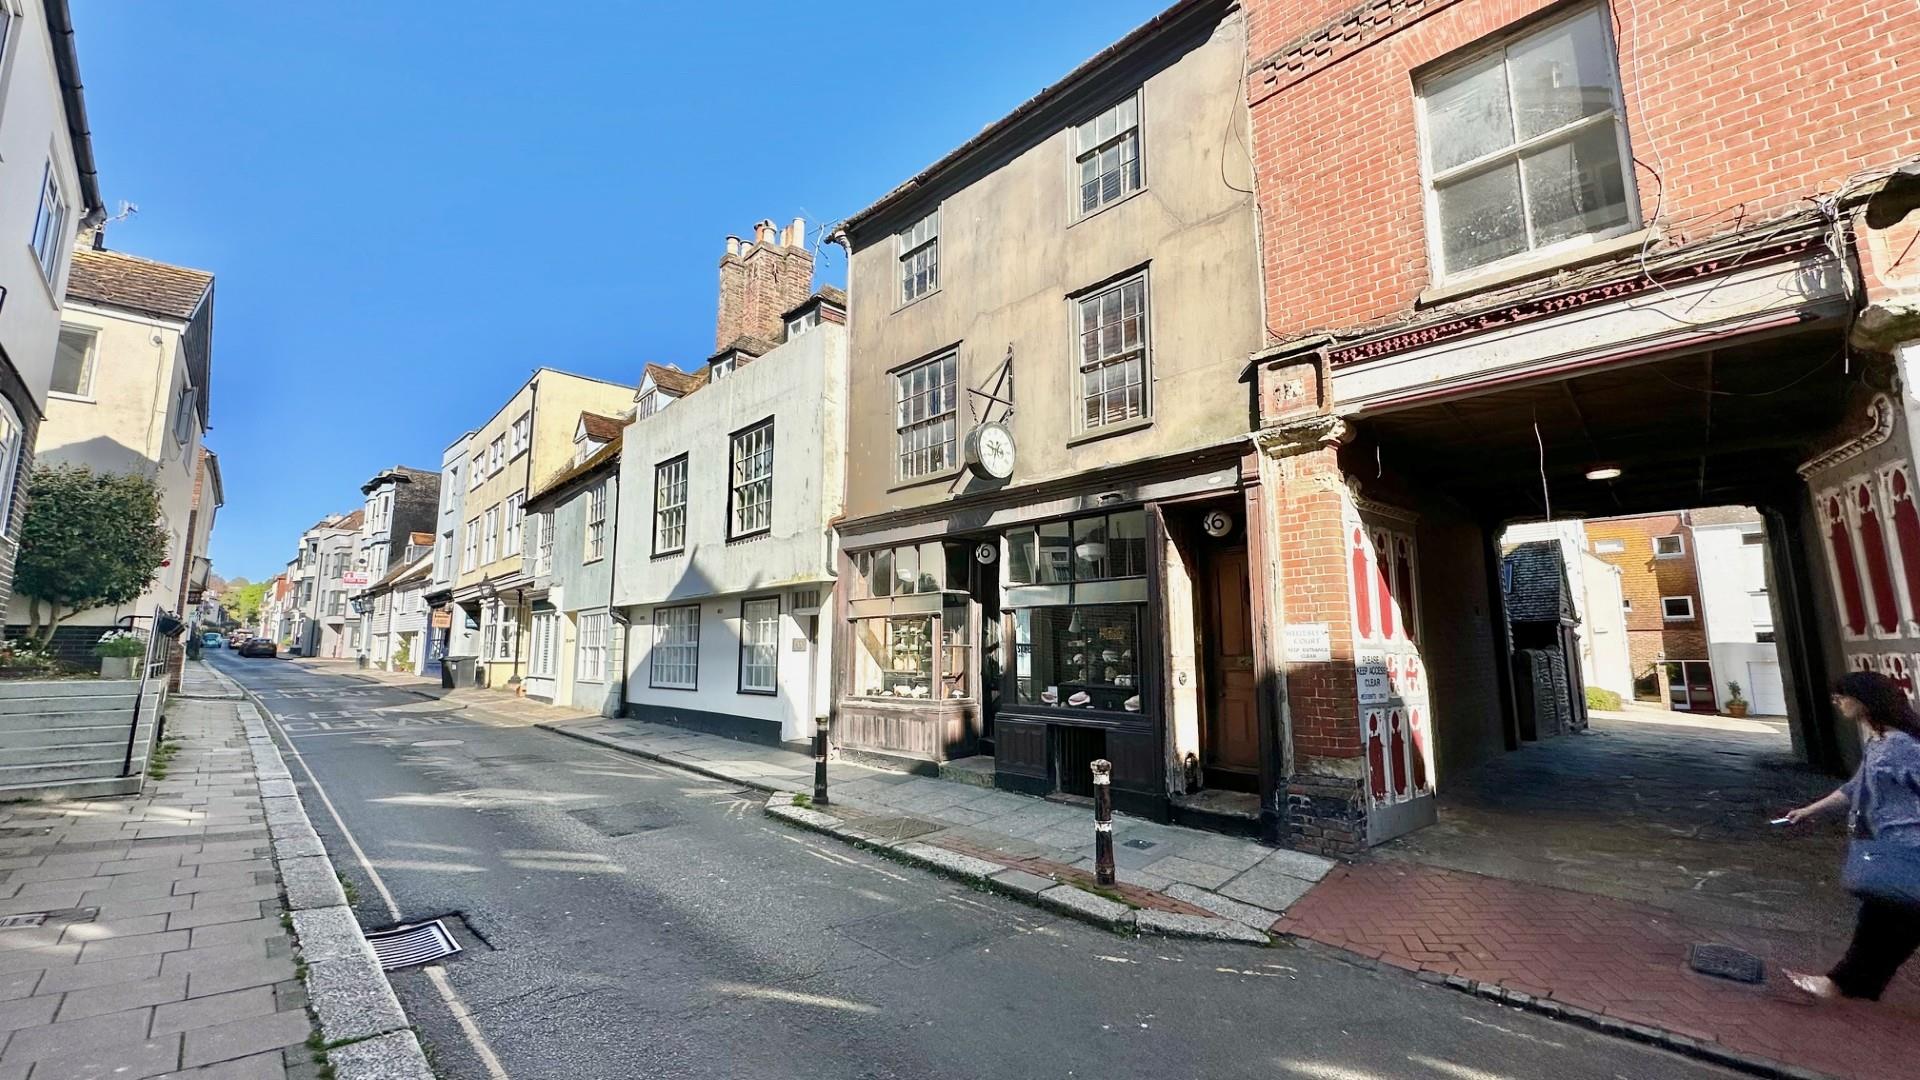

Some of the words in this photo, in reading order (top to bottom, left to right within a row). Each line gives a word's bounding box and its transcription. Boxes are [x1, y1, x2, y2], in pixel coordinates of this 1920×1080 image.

[1362, 655, 1380, 665] PLEASE
[1357, 666, 1368, 675] KEEP
[1369, 666, 1387, 675] ACCESS
[1364, 678, 1381, 687] CLEAR
[282, 716, 464, 731] CLEAR
